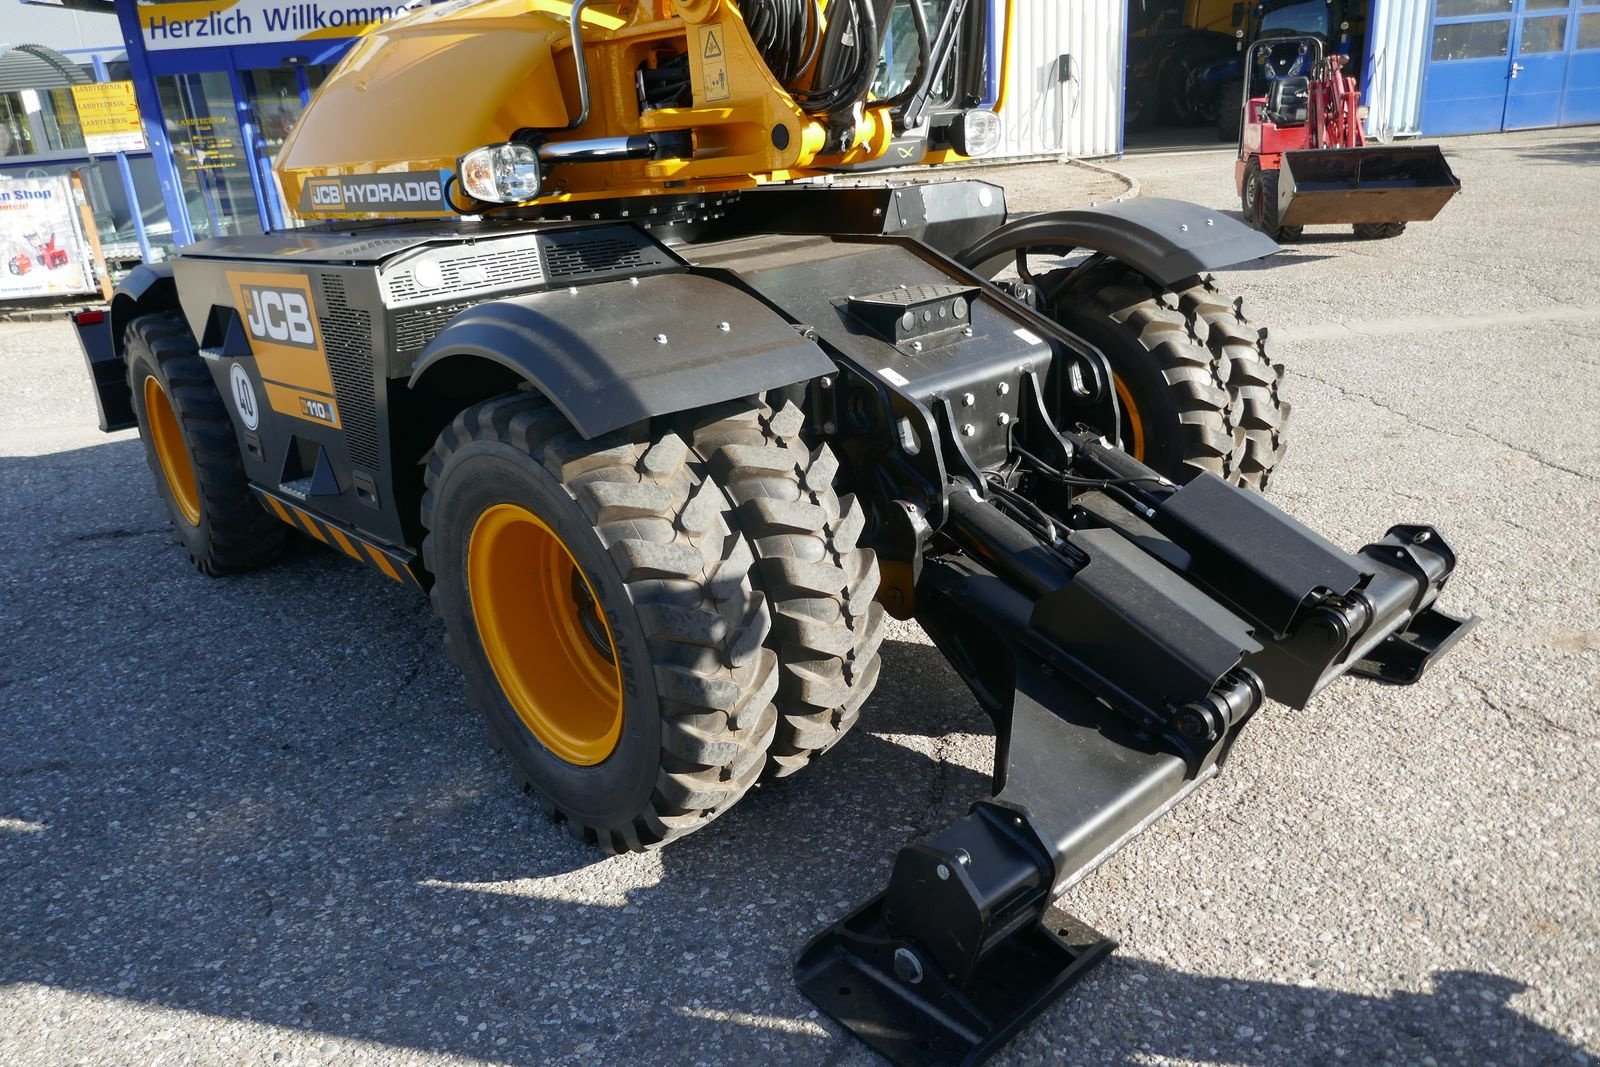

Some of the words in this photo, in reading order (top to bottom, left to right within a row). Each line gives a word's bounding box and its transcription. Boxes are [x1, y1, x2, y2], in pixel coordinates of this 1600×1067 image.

[149, 9, 251, 40] Herzlich
[262, 3, 424, 32] Willkomm
[14, 190, 52, 200] Shop
[313, 185, 341, 205] JCB
[342, 181, 442, 204] HYDRADIG
[248, 290, 315, 344] JCB
[236, 376, 253, 418] 40
